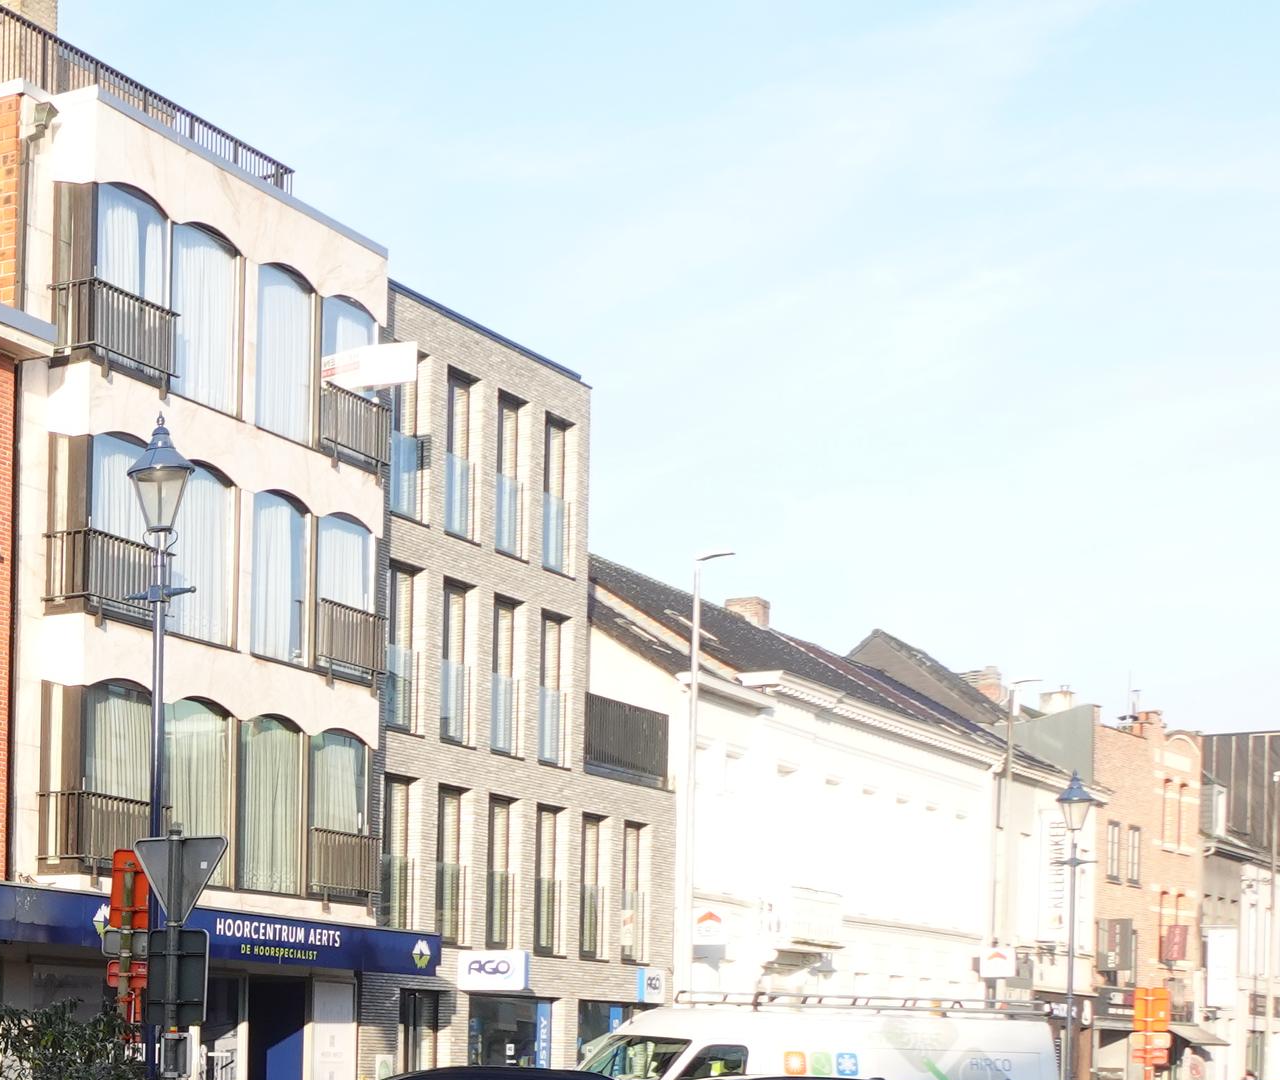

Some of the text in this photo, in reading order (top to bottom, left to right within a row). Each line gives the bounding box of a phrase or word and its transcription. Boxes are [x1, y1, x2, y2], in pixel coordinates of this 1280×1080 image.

[215, 918, 341, 948] HOORCENTRUM AERTS
[241, 944, 318, 961] DE HOORSPECIALIST
[969, 1058, 1012, 1072] AIRCO
